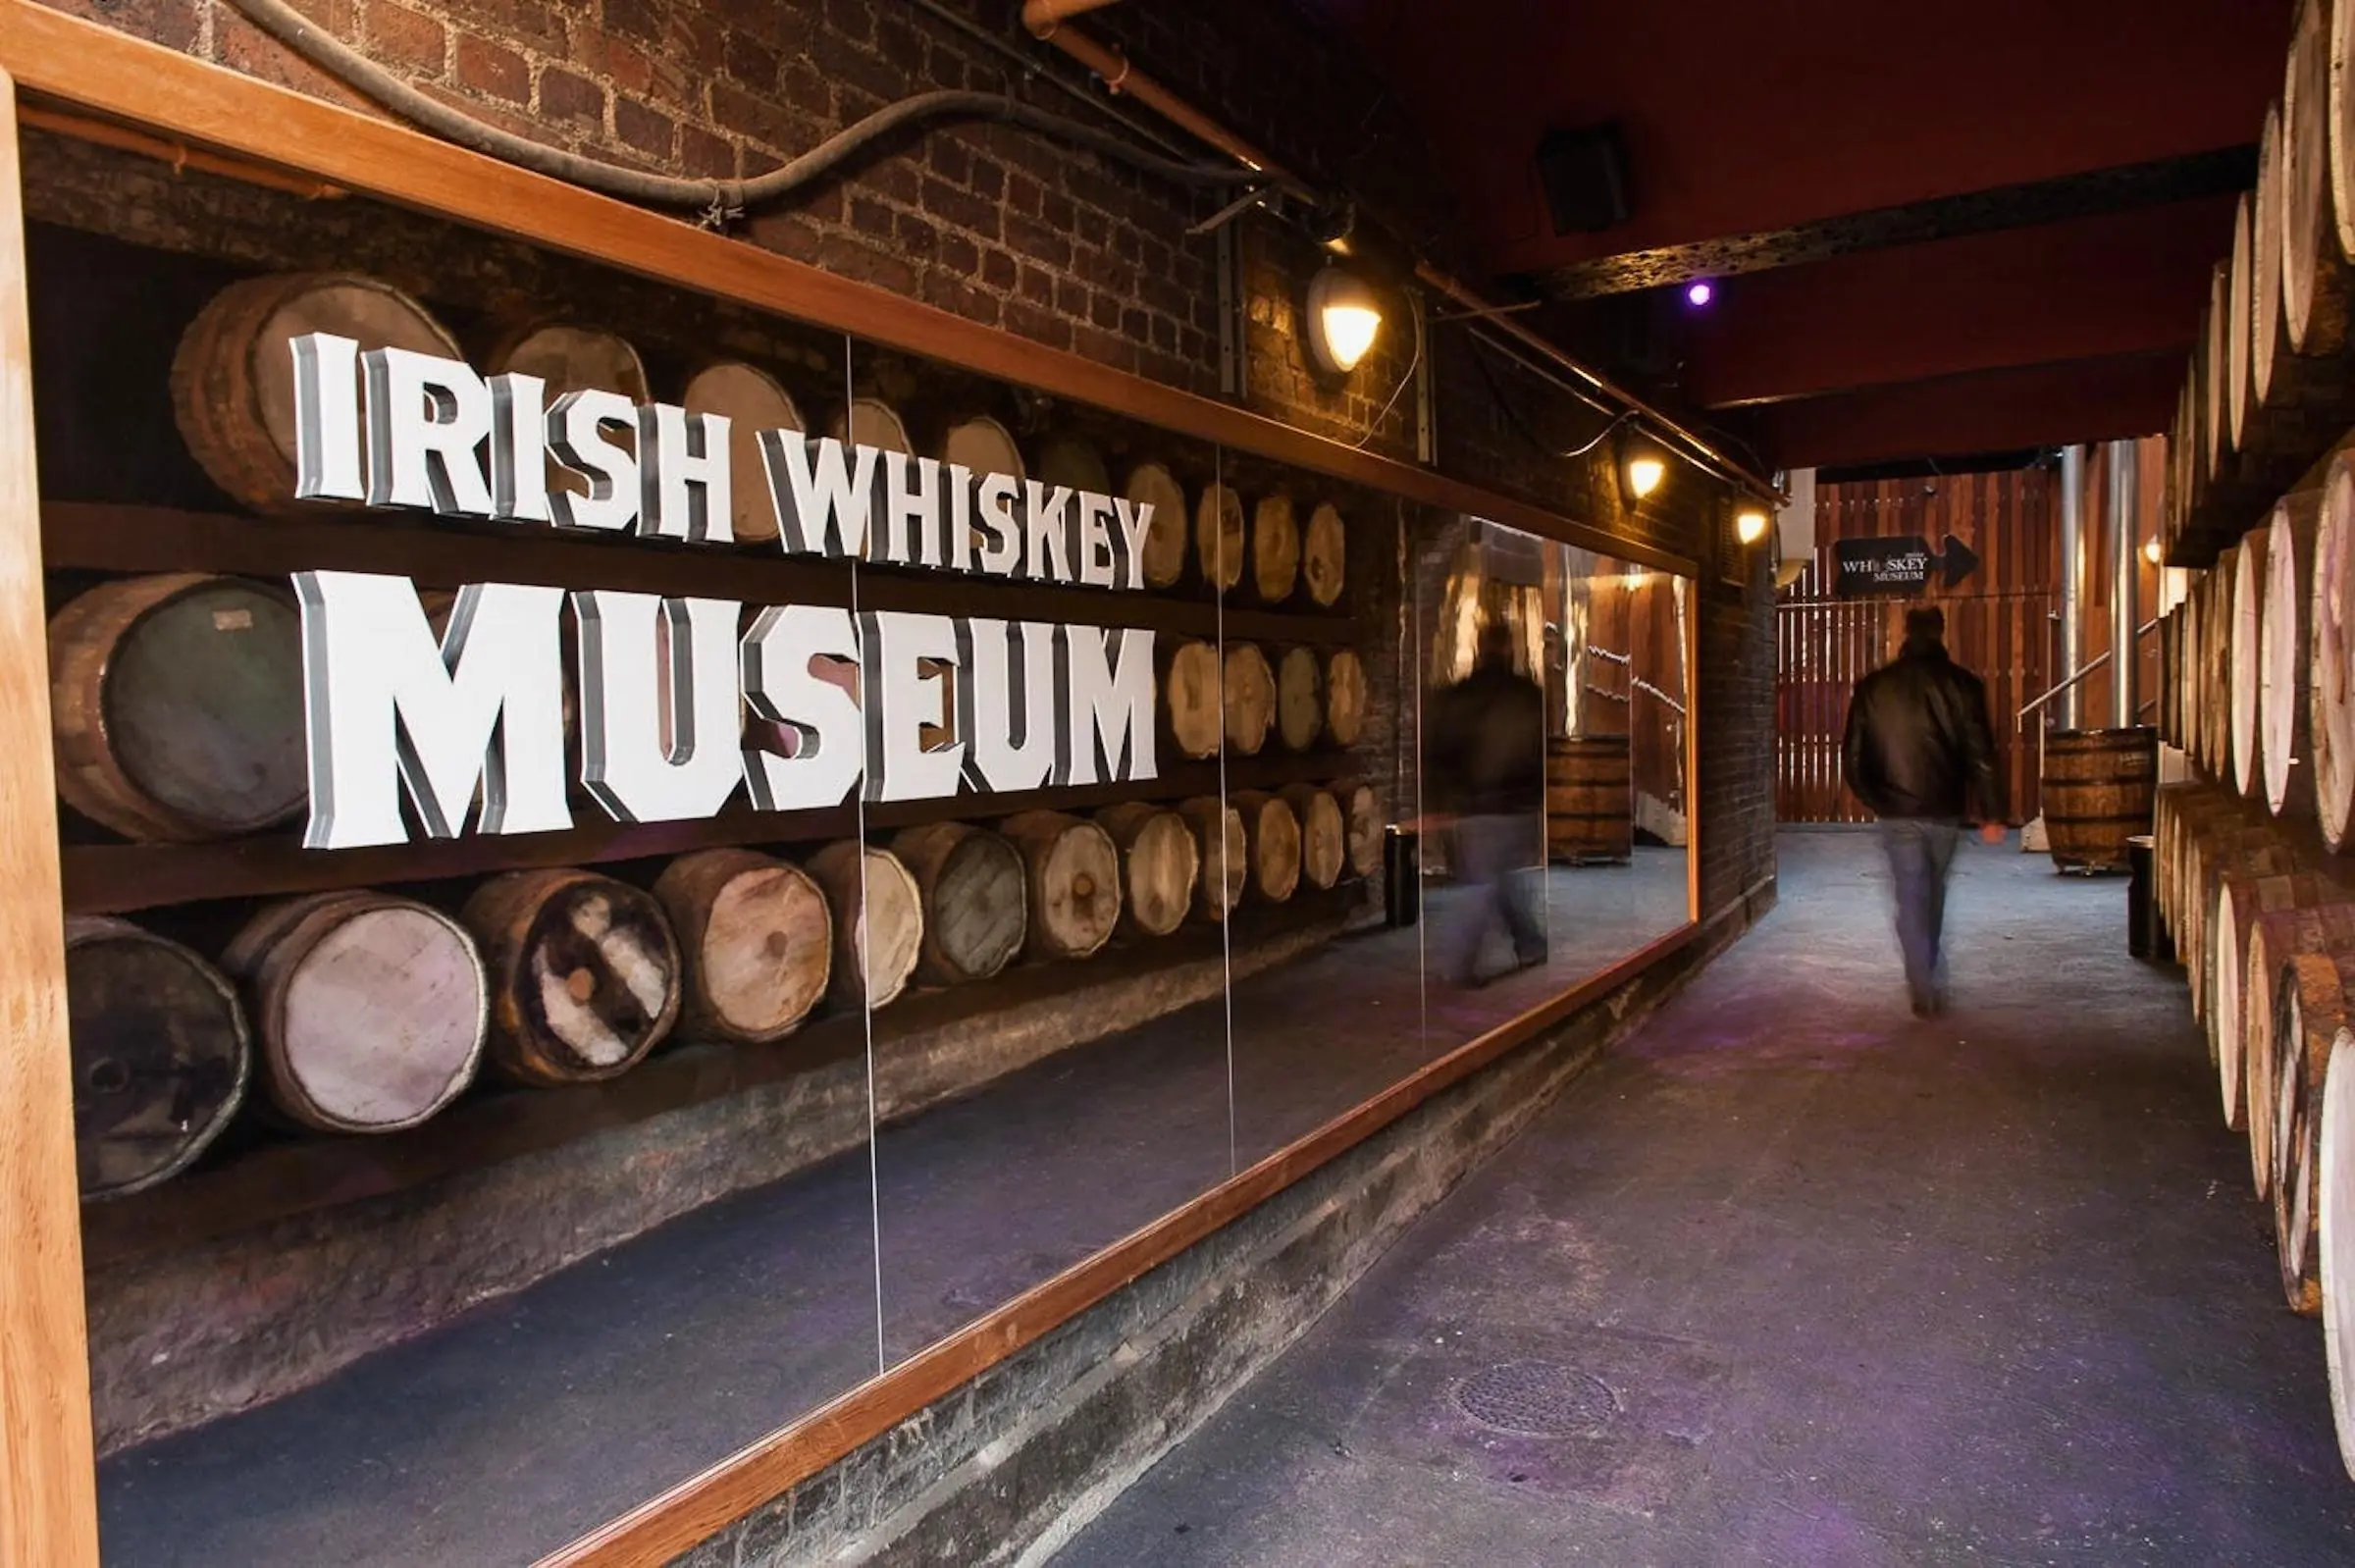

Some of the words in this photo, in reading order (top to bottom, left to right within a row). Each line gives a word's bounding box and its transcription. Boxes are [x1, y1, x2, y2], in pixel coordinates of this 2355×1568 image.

[289, 332, 735, 543] IRISH
[756, 428, 1155, 590] WHISKEY
[1873, 571, 1924, 582] MUSEUM
[289, 569, 1158, 851] MUSEUM
